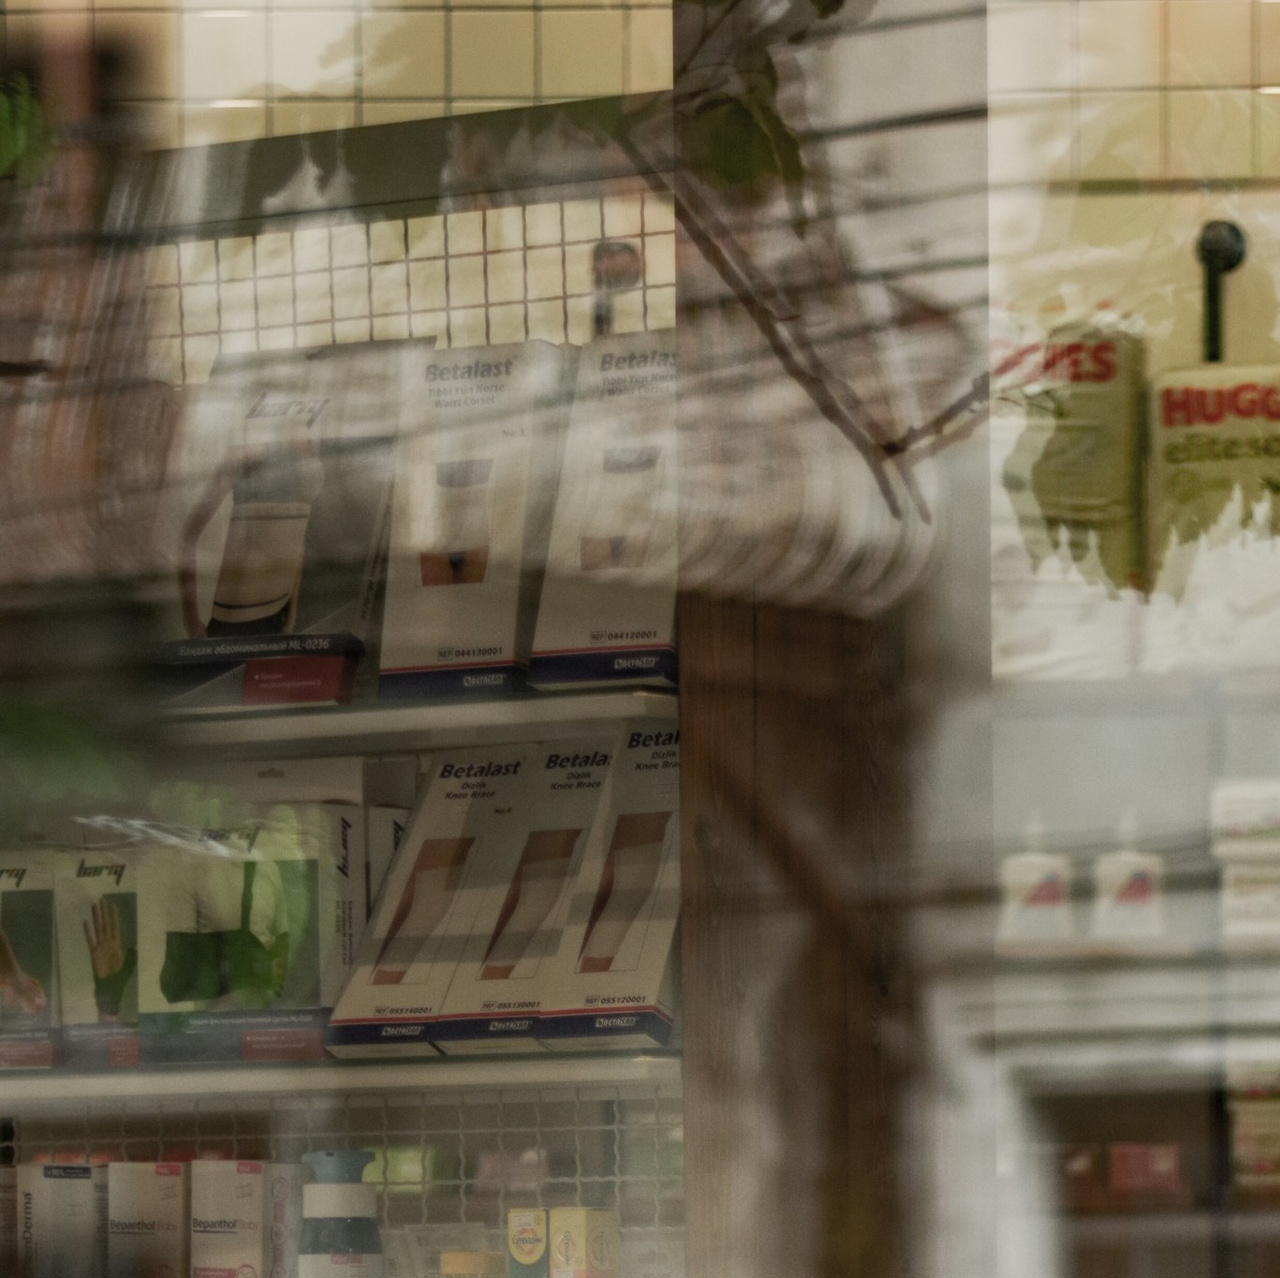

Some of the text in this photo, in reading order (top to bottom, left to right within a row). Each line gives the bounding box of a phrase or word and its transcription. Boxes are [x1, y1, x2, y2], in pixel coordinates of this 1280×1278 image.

[425, 359, 514, 382] Betalast
[607, 630, 657, 641] 044120001
[288, 638, 330, 651] ML-0236
[454, 647, 503, 658] 044130001
[651, 750, 677, 760] Dizlik
[439, 760, 521, 780] Betalast
[635, 762, 660, 771] Knee
[566, 771, 592, 780] Dizlik
[461, 780, 487, 791] Dizlik
[550, 780, 574, 791] Knee
[444, 789, 496, 800] Knee Brace
[76, 859, 126, 887] barry
[600, 995, 646, 1005] 055120001
[389, 1006, 432, 1015] 055140001
[110, 1219, 156, 1232] Bepanthol
[192, 1218, 260, 1232] Bepanthol Baby
